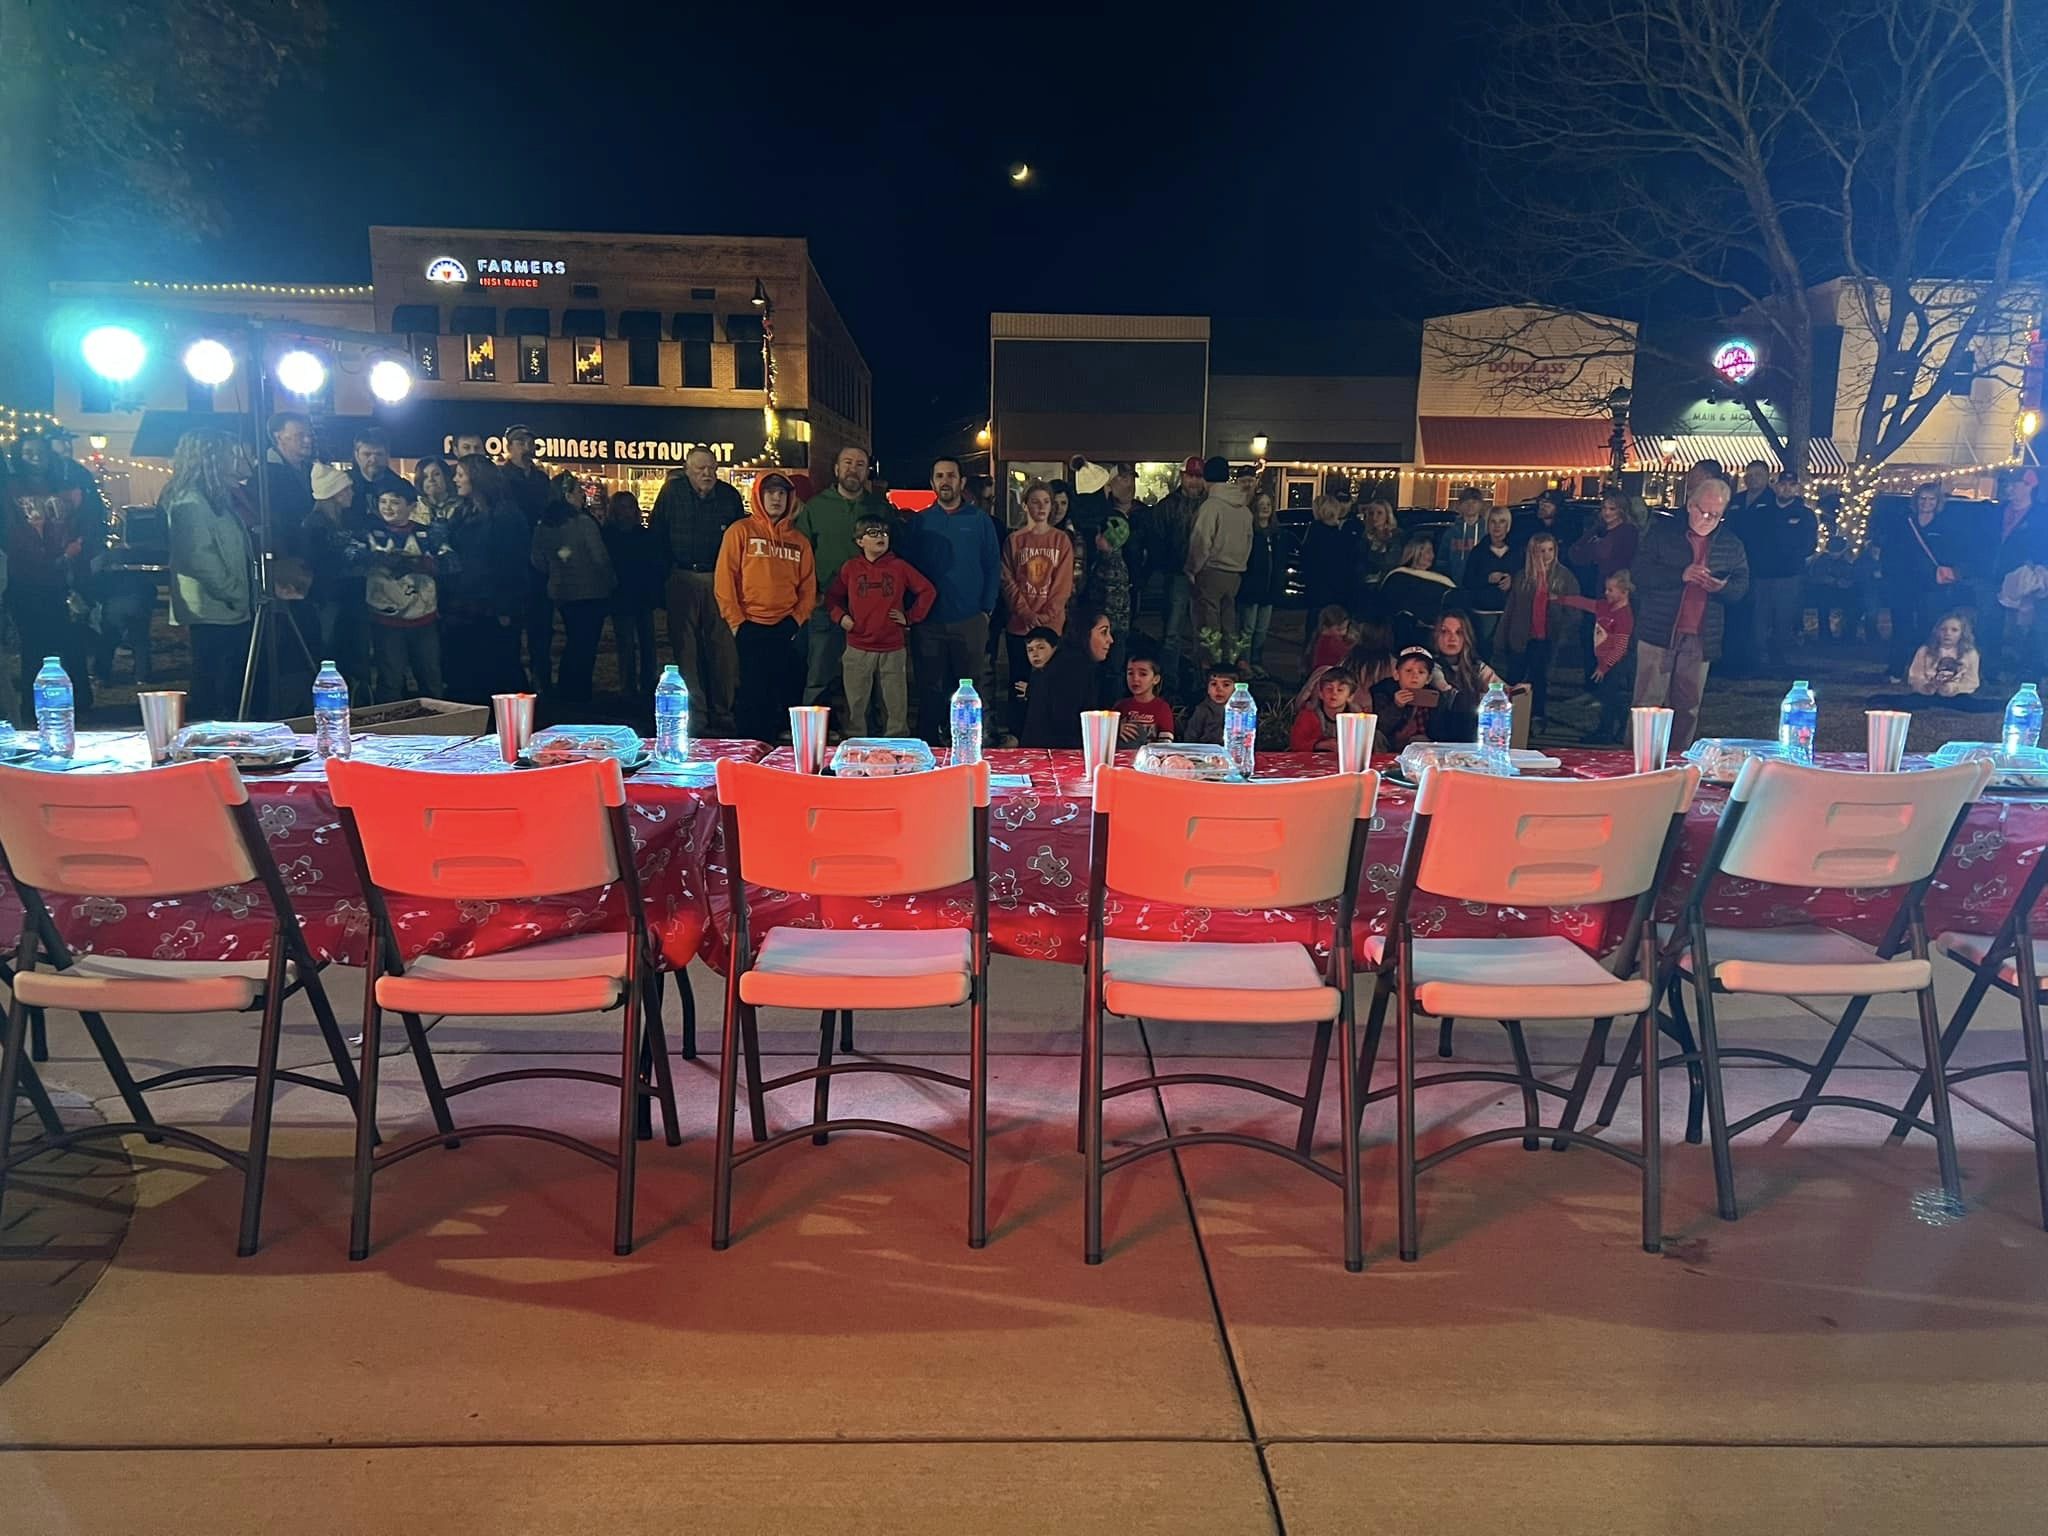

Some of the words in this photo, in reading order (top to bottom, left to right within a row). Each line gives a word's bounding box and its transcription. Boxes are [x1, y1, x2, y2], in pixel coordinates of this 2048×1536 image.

[477, 259, 566, 274] FARMERS
[534, 438, 608, 459] CHINESE
[614, 440, 734, 462] RESTAURNT
[749, 538, 768, 556] T
